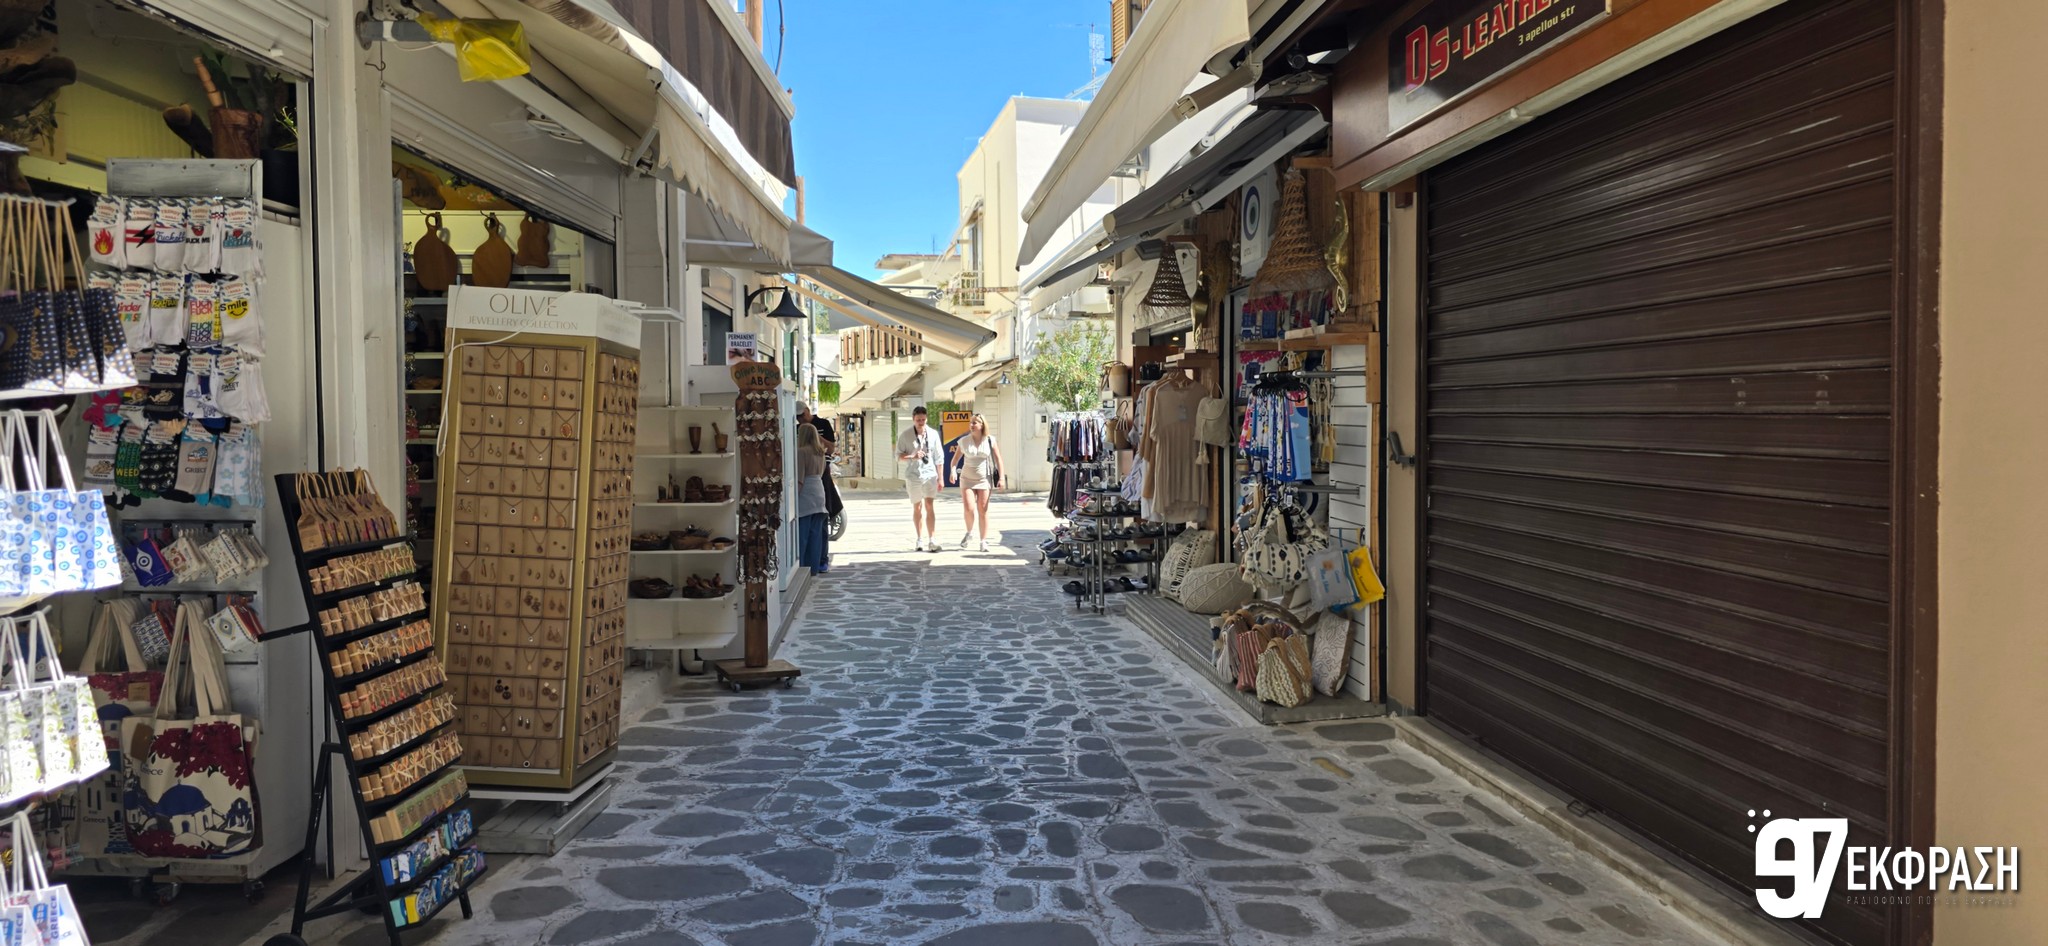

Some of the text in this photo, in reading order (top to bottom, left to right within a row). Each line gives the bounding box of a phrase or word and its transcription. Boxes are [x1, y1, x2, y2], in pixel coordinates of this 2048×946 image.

[1518, 5, 1576, 46] 3 apellou str
[220, 300, 248, 311] Smile
[489, 293, 558, 316] OLIVE
[467, 315, 578, 330] JEWELLERY COLLECTION
[750, 376, 770, 386] ABC
[116, 468, 139, 477] WEED
[50, 895, 59, 939] GREECE
